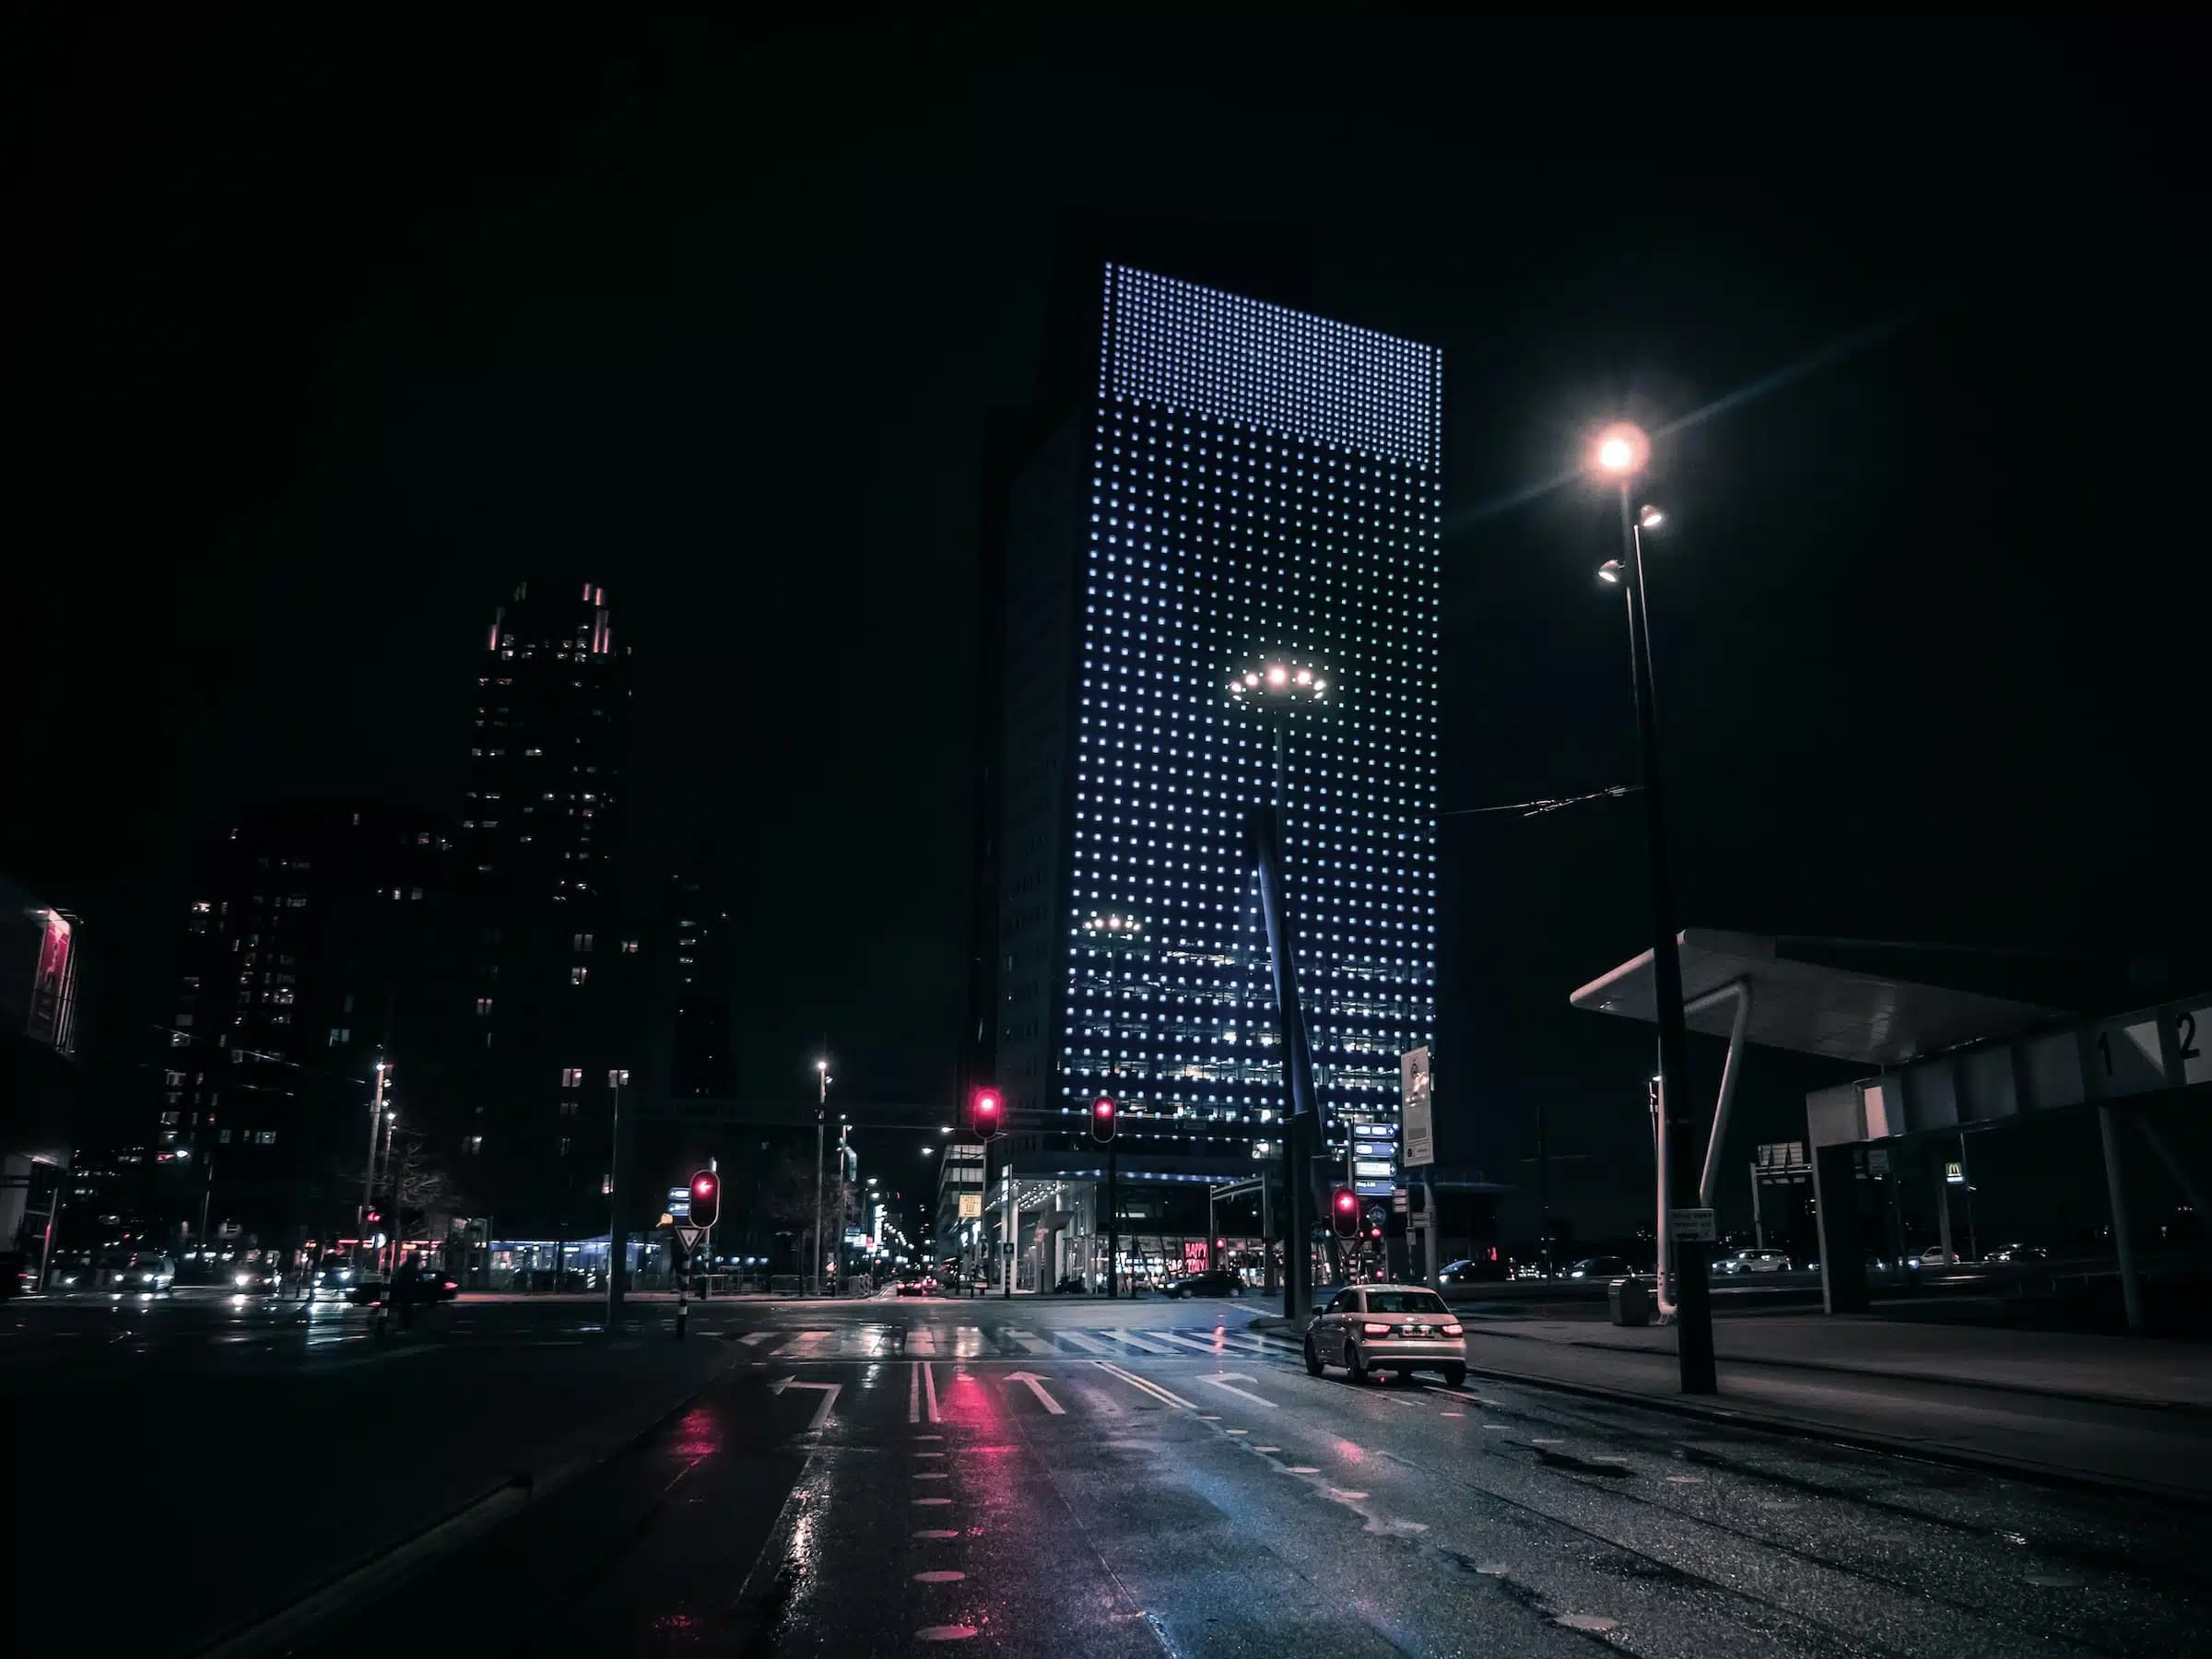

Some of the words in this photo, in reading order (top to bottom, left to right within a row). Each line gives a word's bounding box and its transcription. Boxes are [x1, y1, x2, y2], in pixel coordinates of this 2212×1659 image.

[2098, 1031, 2113, 1077] 1
[2176, 1012, 2201, 1060] 2
[1184, 1242, 1207, 1259] HAPPY
